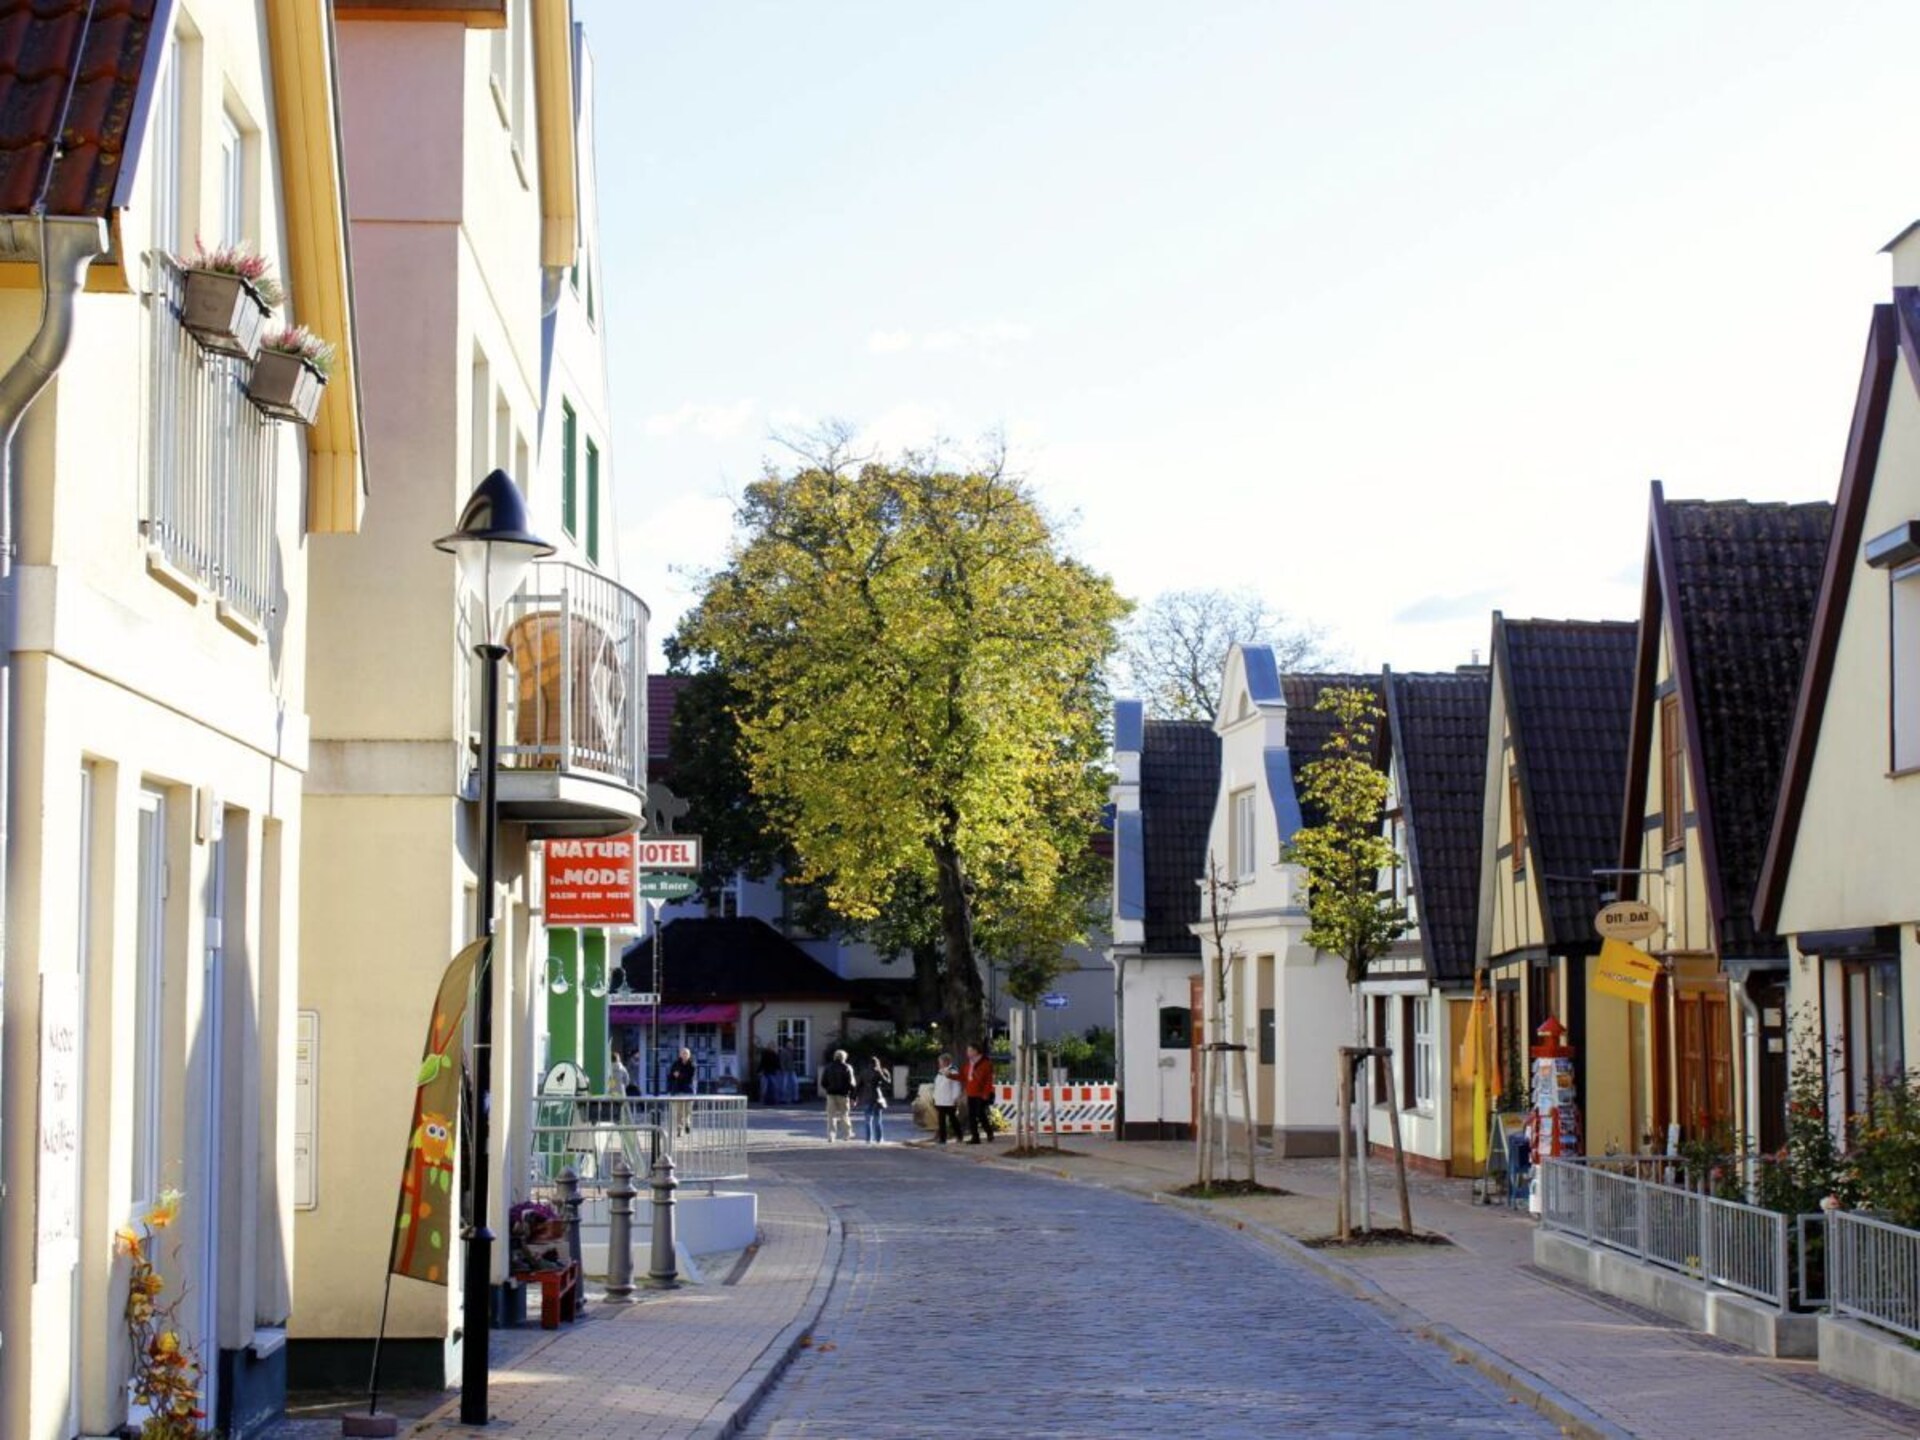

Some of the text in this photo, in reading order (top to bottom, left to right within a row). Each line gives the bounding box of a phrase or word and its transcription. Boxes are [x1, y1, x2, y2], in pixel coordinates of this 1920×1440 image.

[551, 841, 630, 858] NATUR
[564, 868, 630, 885] MODE
[1606, 911, 1649, 923] DIT DAT
